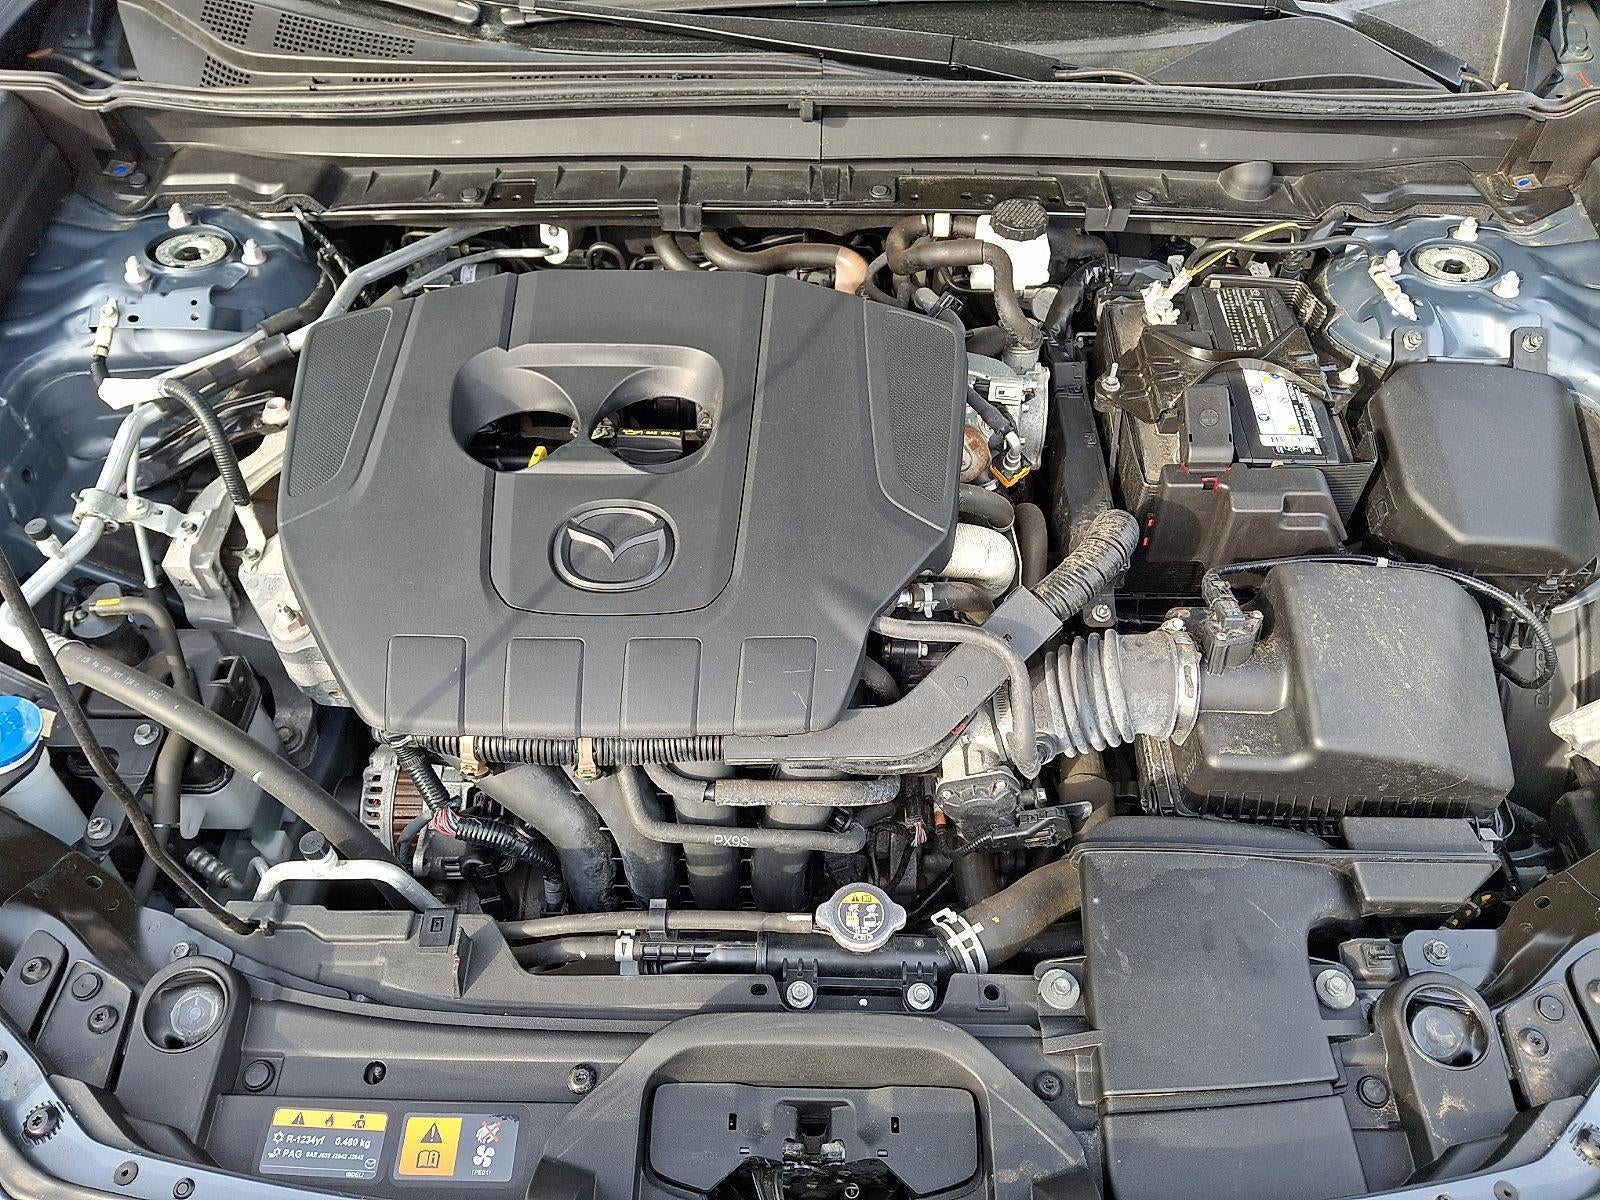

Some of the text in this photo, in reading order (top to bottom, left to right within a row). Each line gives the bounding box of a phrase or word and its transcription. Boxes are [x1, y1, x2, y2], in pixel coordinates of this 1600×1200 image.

[713, 834, 749, 847] PX9S
[285, 1134, 371, 1149] R-1234yf 0.480 kg
[282, 1148, 303, 1159] PAG
